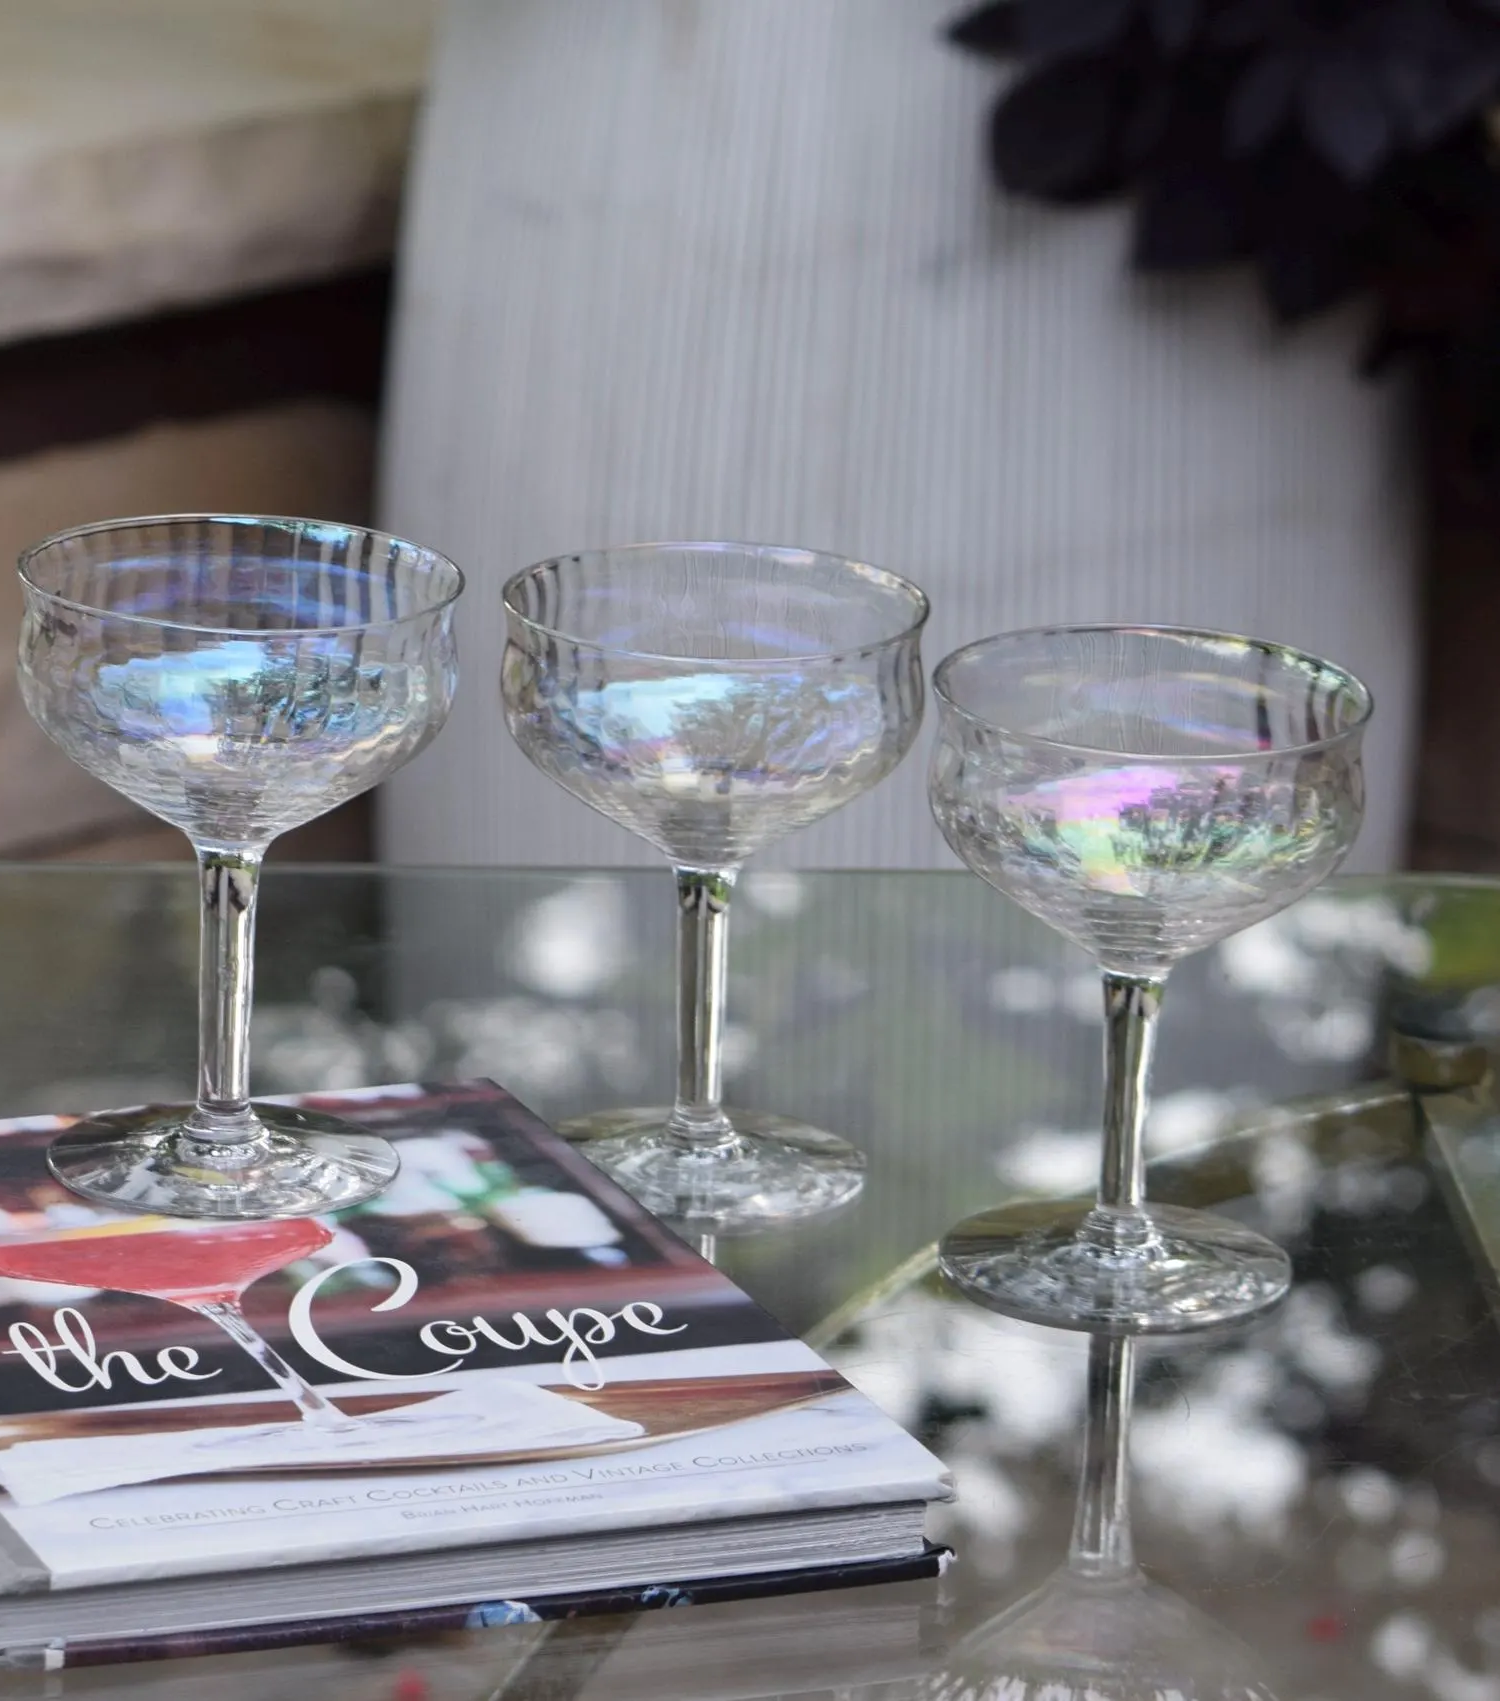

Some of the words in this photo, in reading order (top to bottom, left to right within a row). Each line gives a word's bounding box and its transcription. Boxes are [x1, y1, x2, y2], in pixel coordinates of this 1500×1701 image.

[2, 1307, 222, 1393] the
[288, 1257, 688, 1391] Coupe
[89, 1502, 266, 1531] CELEBRATING
[272, 1494, 357, 1512] CRAFT
[366, 1478, 508, 1502] COCKTAILS
[516, 1474, 568, 1489] AND
[571, 1460, 683, 1482] VINTAGE
[692, 1441, 868, 1468] COLLECTIONS
